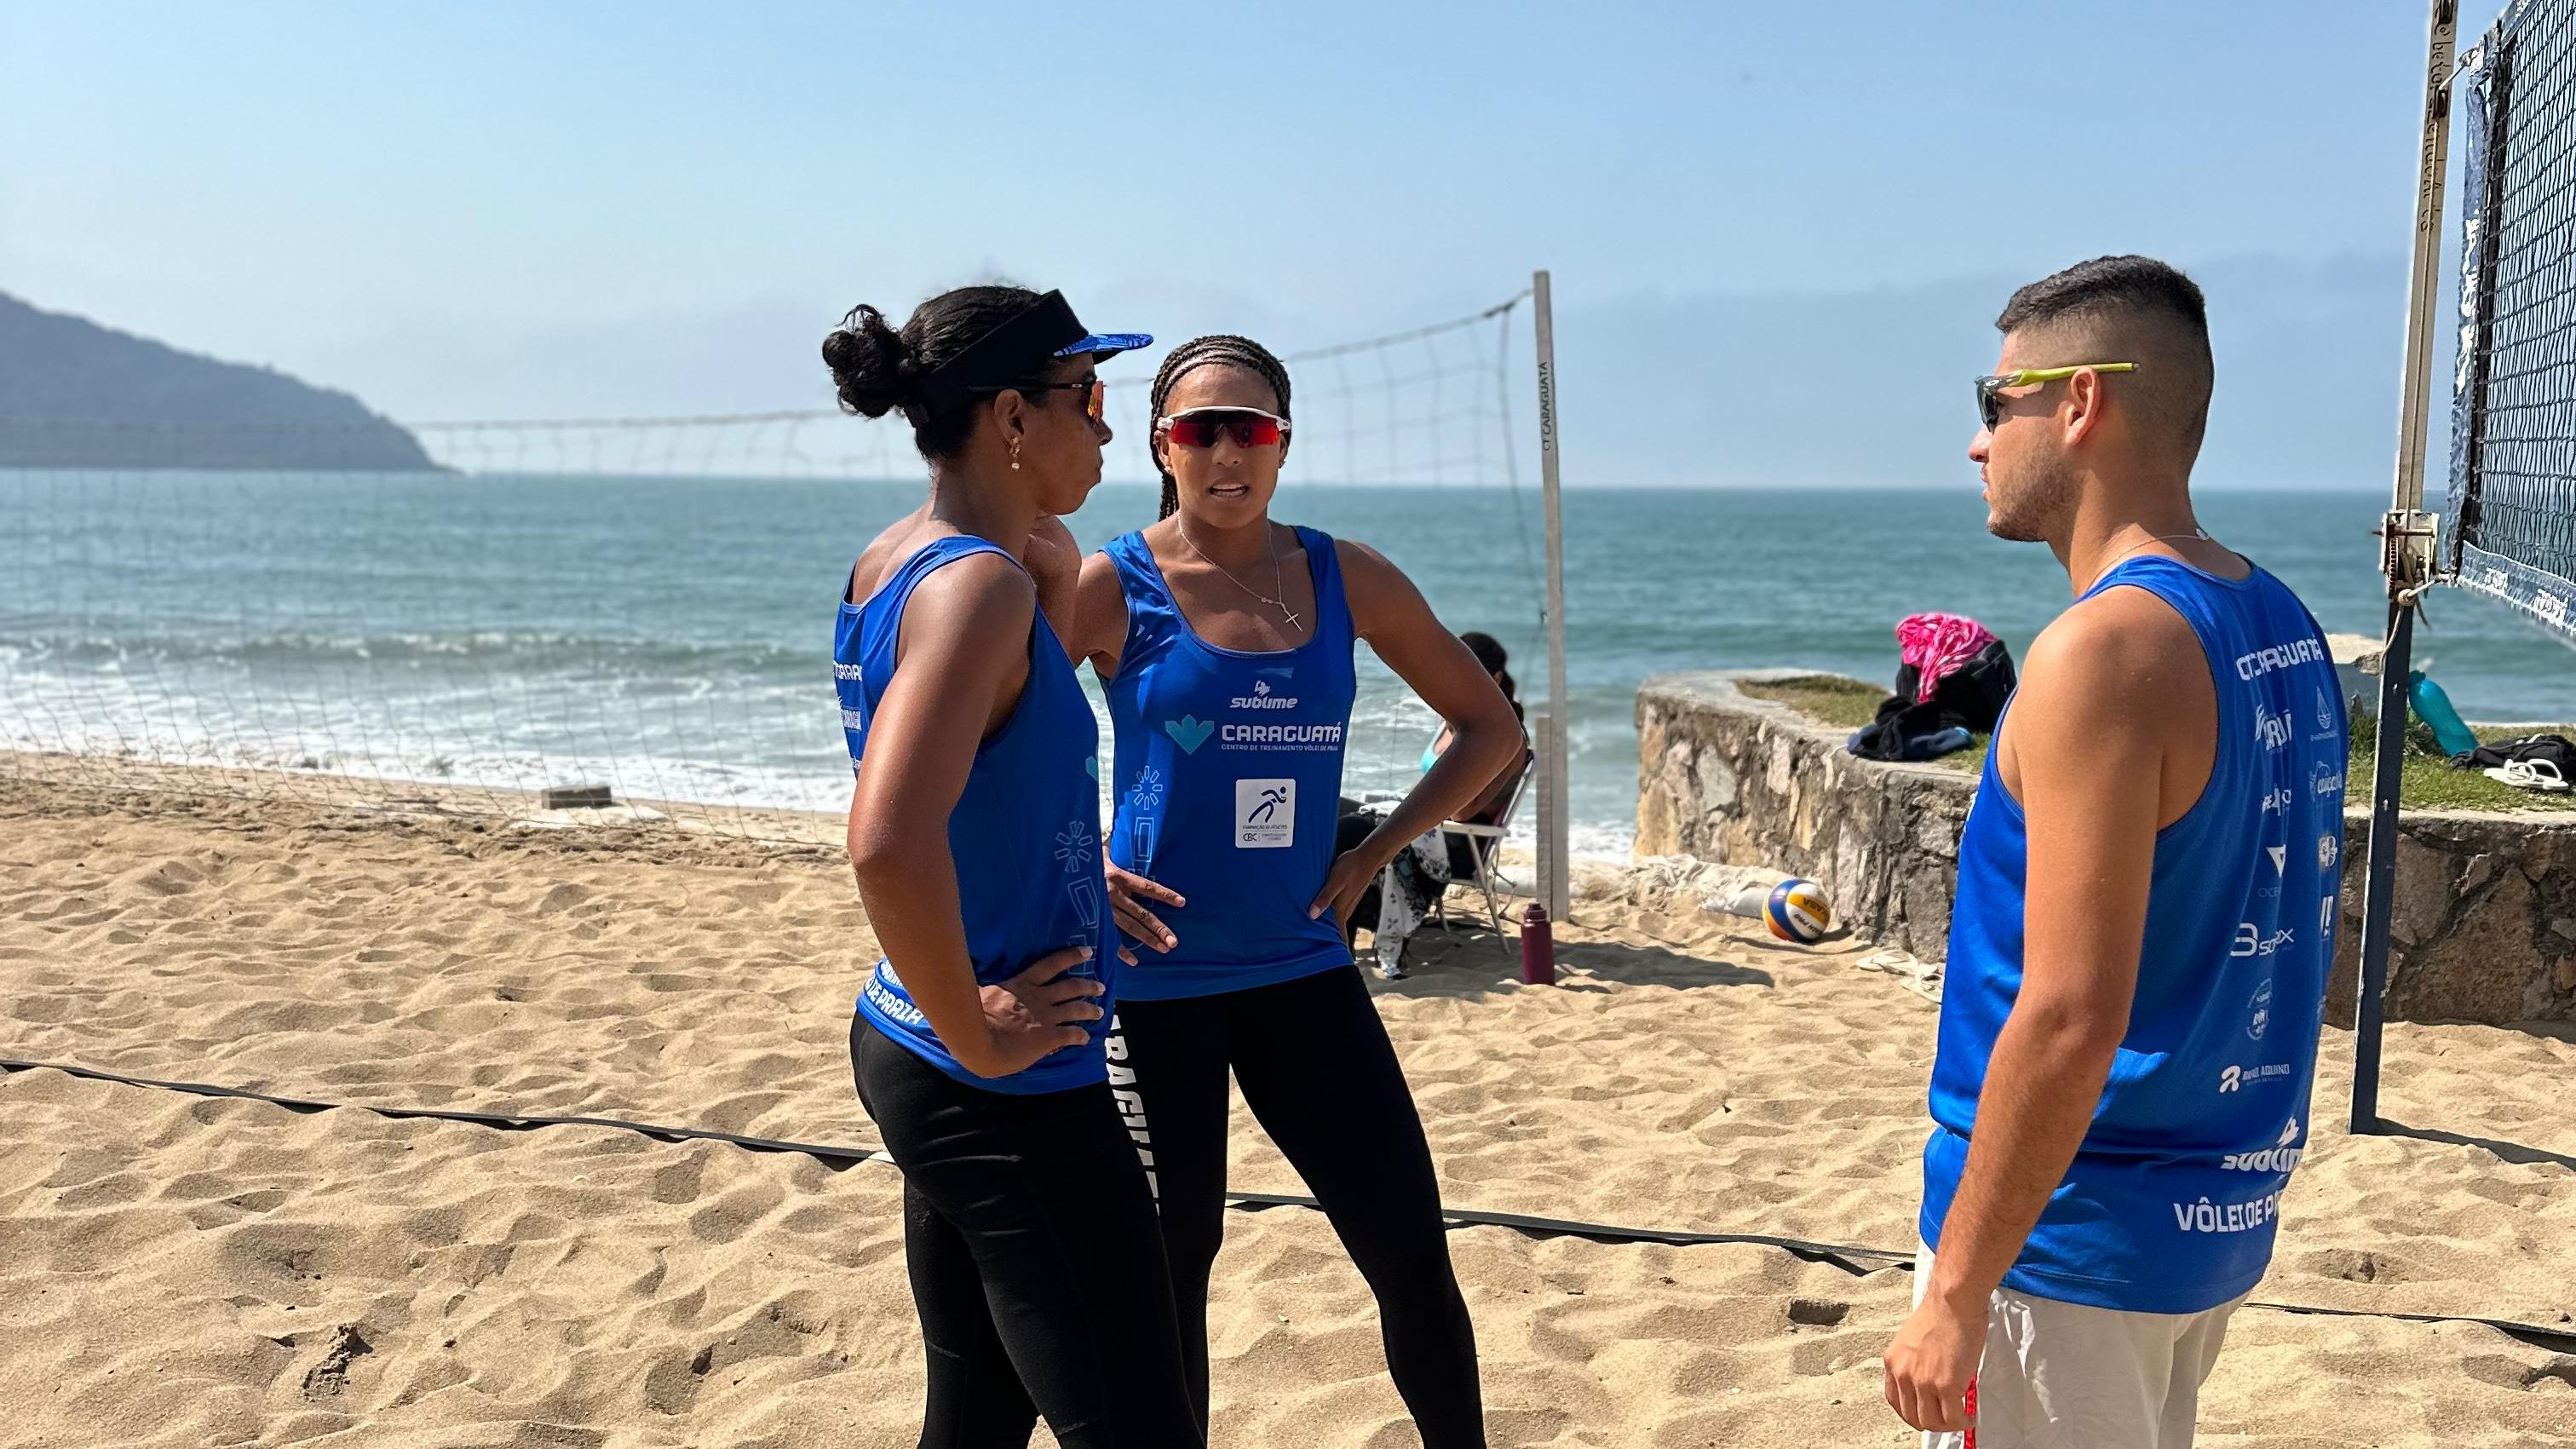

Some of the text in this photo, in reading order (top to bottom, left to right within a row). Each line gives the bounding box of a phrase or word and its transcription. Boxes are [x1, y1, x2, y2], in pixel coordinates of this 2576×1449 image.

[1222, 721, 1342, 743] CARAGUATÁ
[875, 988, 925, 1026] PRAIA
[2173, 1196, 2243, 1233] VÔLEI
[2245, 1199, 2263, 1229] DE
